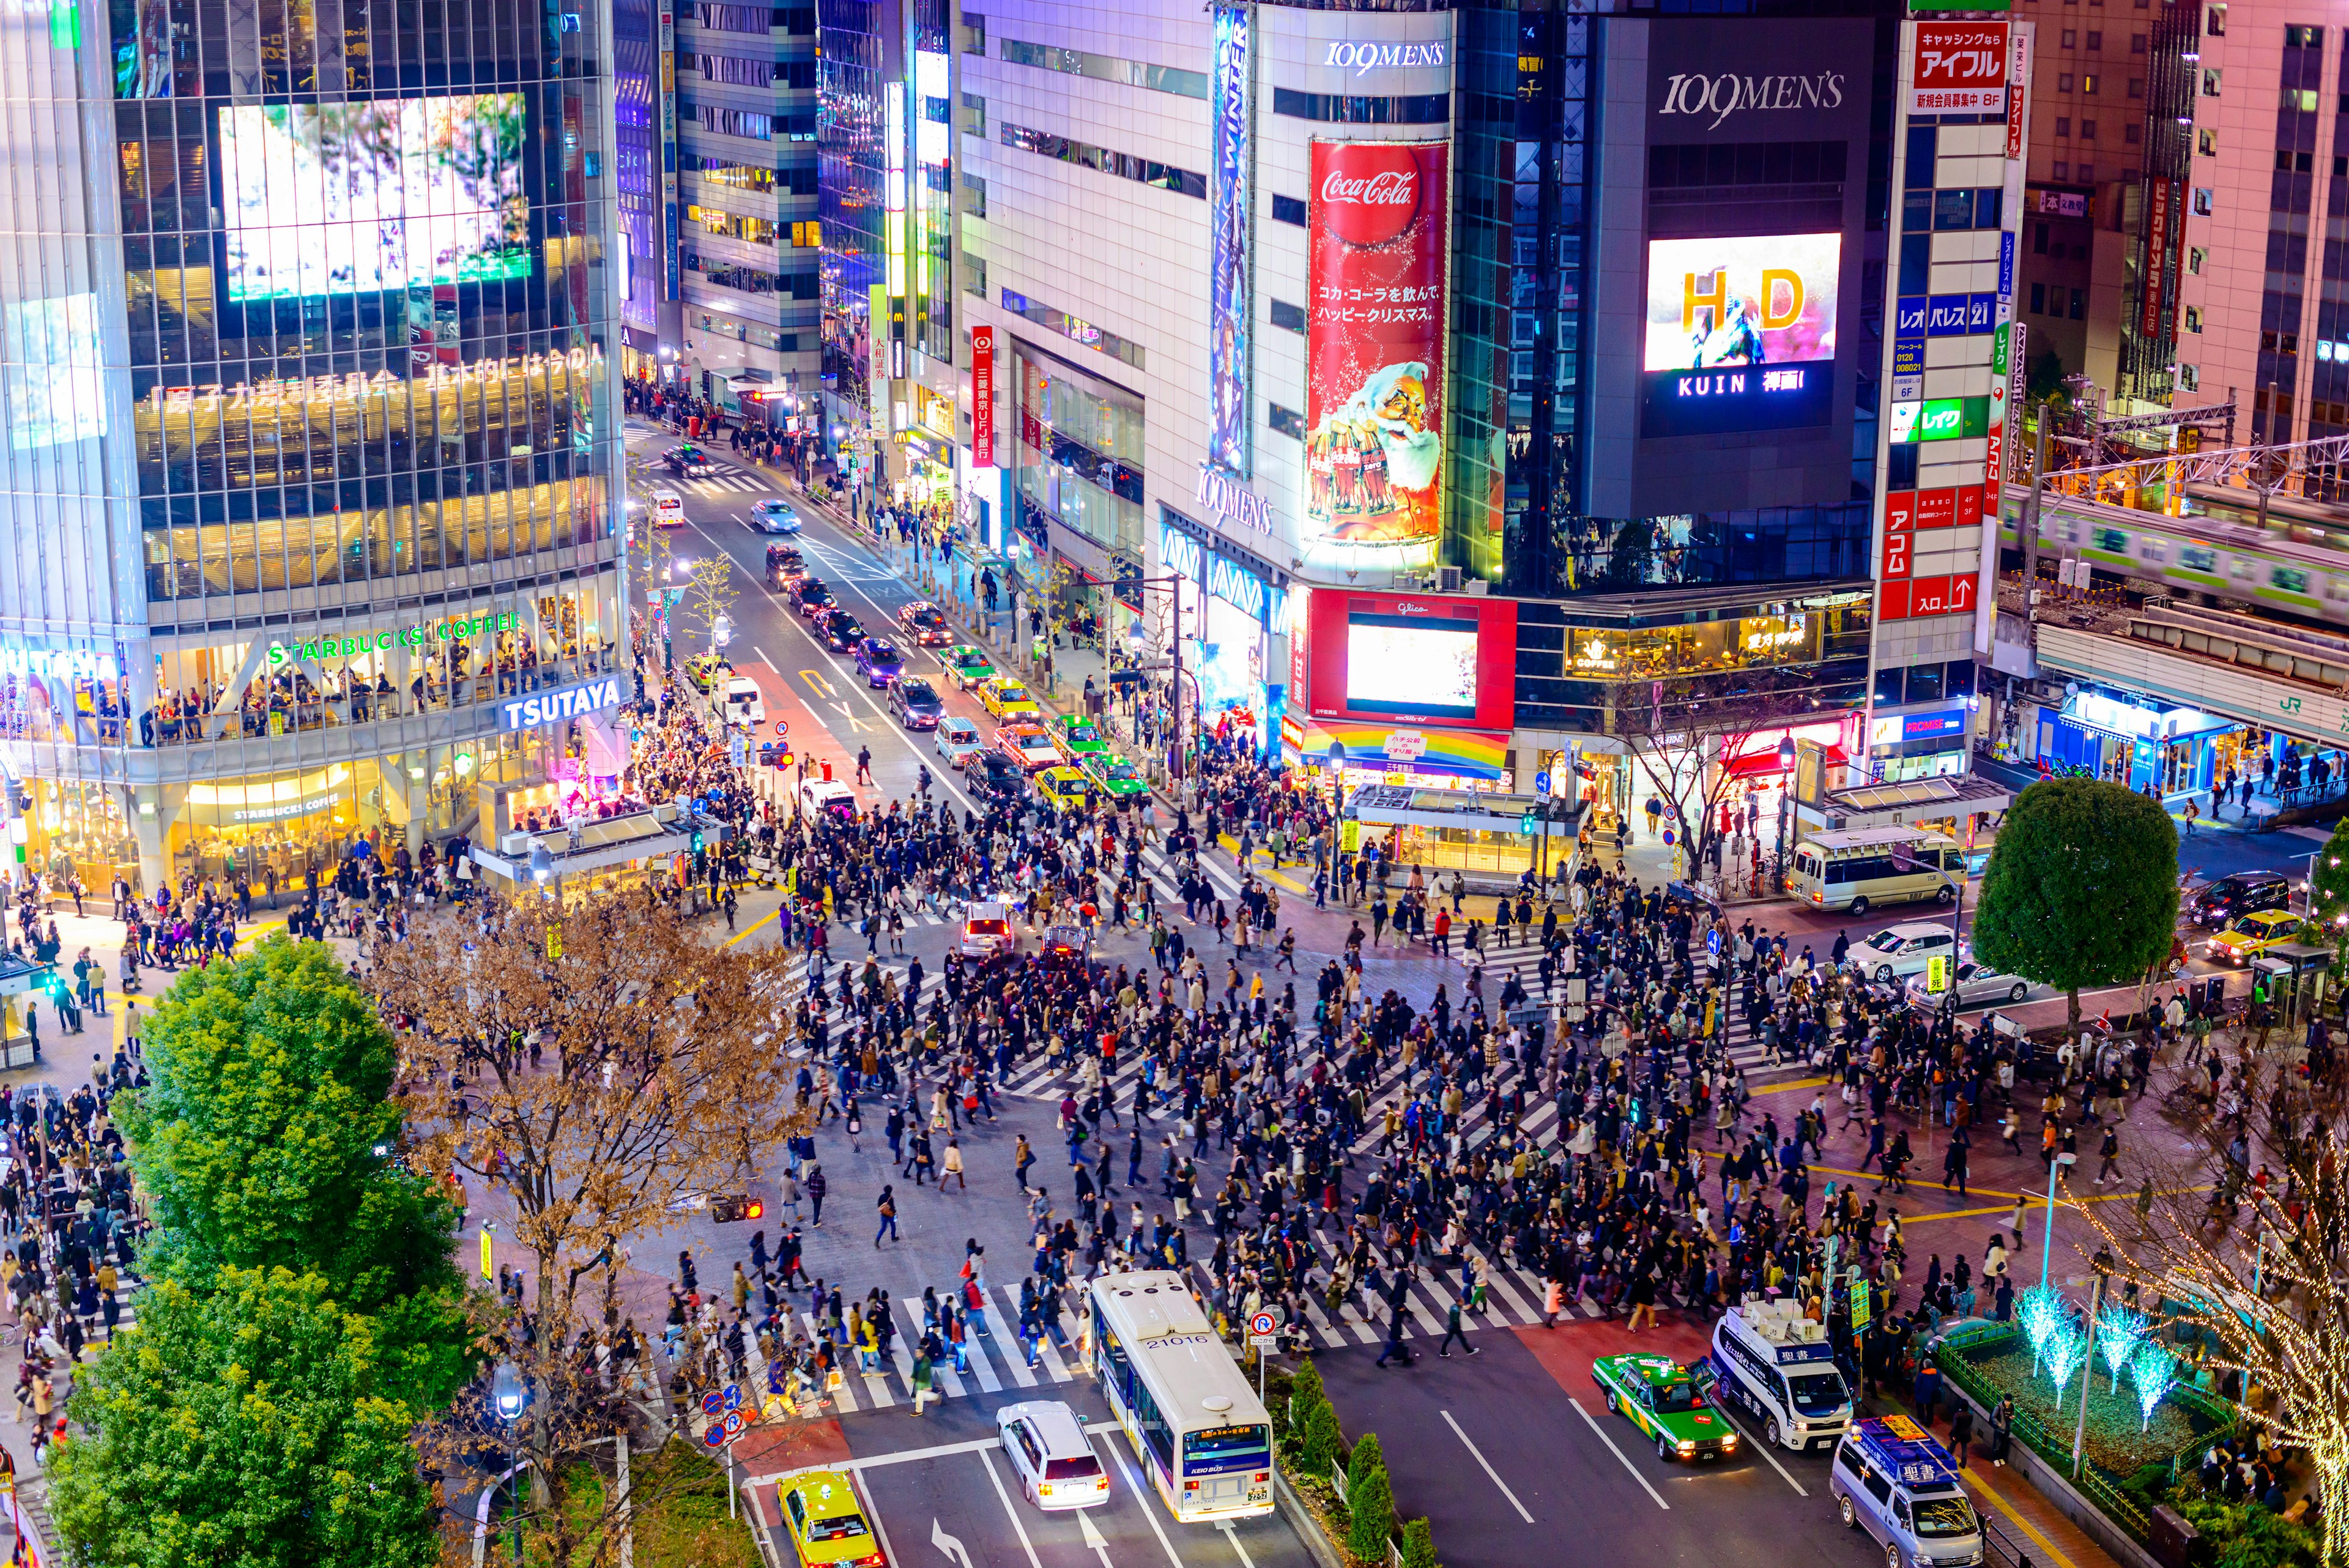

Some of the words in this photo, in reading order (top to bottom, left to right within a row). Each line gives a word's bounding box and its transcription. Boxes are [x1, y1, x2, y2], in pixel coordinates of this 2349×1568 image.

[1923, 34, 2000, 45] キャッシングなら
[1324, 42, 1444, 76] 109MEN'S
[1921, 51, 2000, 78] アイフル
[1224, 24, 1247, 170] WINTER
[1659, 70, 1845, 131] 109MEN'S
[1917, 93, 1978, 108] 新規会員募集中
[1983, 94, 2000, 106] 8F
[2009, 100, 2021, 151] アイフル
[1321, 170, 1417, 205] Coca-Cola
[2151, 182, 2167, 288] ビックカメラ
[1214, 175, 1235, 331] SHINING
[1318, 307, 1433, 323] ハッピークリスマス。
[2147, 291, 2157, 331] 東口店
[874, 338, 885, 379] 大和証券
[1897, 353, 1913, 362] 0120
[1997, 332, 2006, 365] レイク
[1896, 363, 1921, 372] 008021
[1901, 387, 1912, 397] 6F
[977, 368, 989, 459] 三菱東京UFJ銀行
[1922, 410, 1961, 429] レイク
[1364, 461, 1381, 471] zero
[1988, 436, 2001, 480] アコム
[1195, 468, 1273, 536] 109MEN'S
[1888, 510, 1908, 573] アコム
[1398, 603, 1428, 614] Glico
[1918, 597, 1940, 611] 入口
[268, 626, 423, 665] STARBUCKS
[437, 611, 521, 641] COFFEE
[1576, 658, 1615, 669] COFFEE
[505, 680, 620, 729] TSUTAYA
[2280, 697, 2301, 713] JR
[1906, 719, 1944, 733] PROMISE
[1386, 763, 1414, 773] 三千里薬品
[234, 803, 304, 820] STARBUCKS
[306, 793, 338, 810] COFFEE
[1146, 1336, 1208, 1349] 21016
[1781, 1350, 1808, 1361] 聖書
[1743, 1391, 1761, 1417] 聖書
[1904, 1464, 1935, 1481] 聖書
